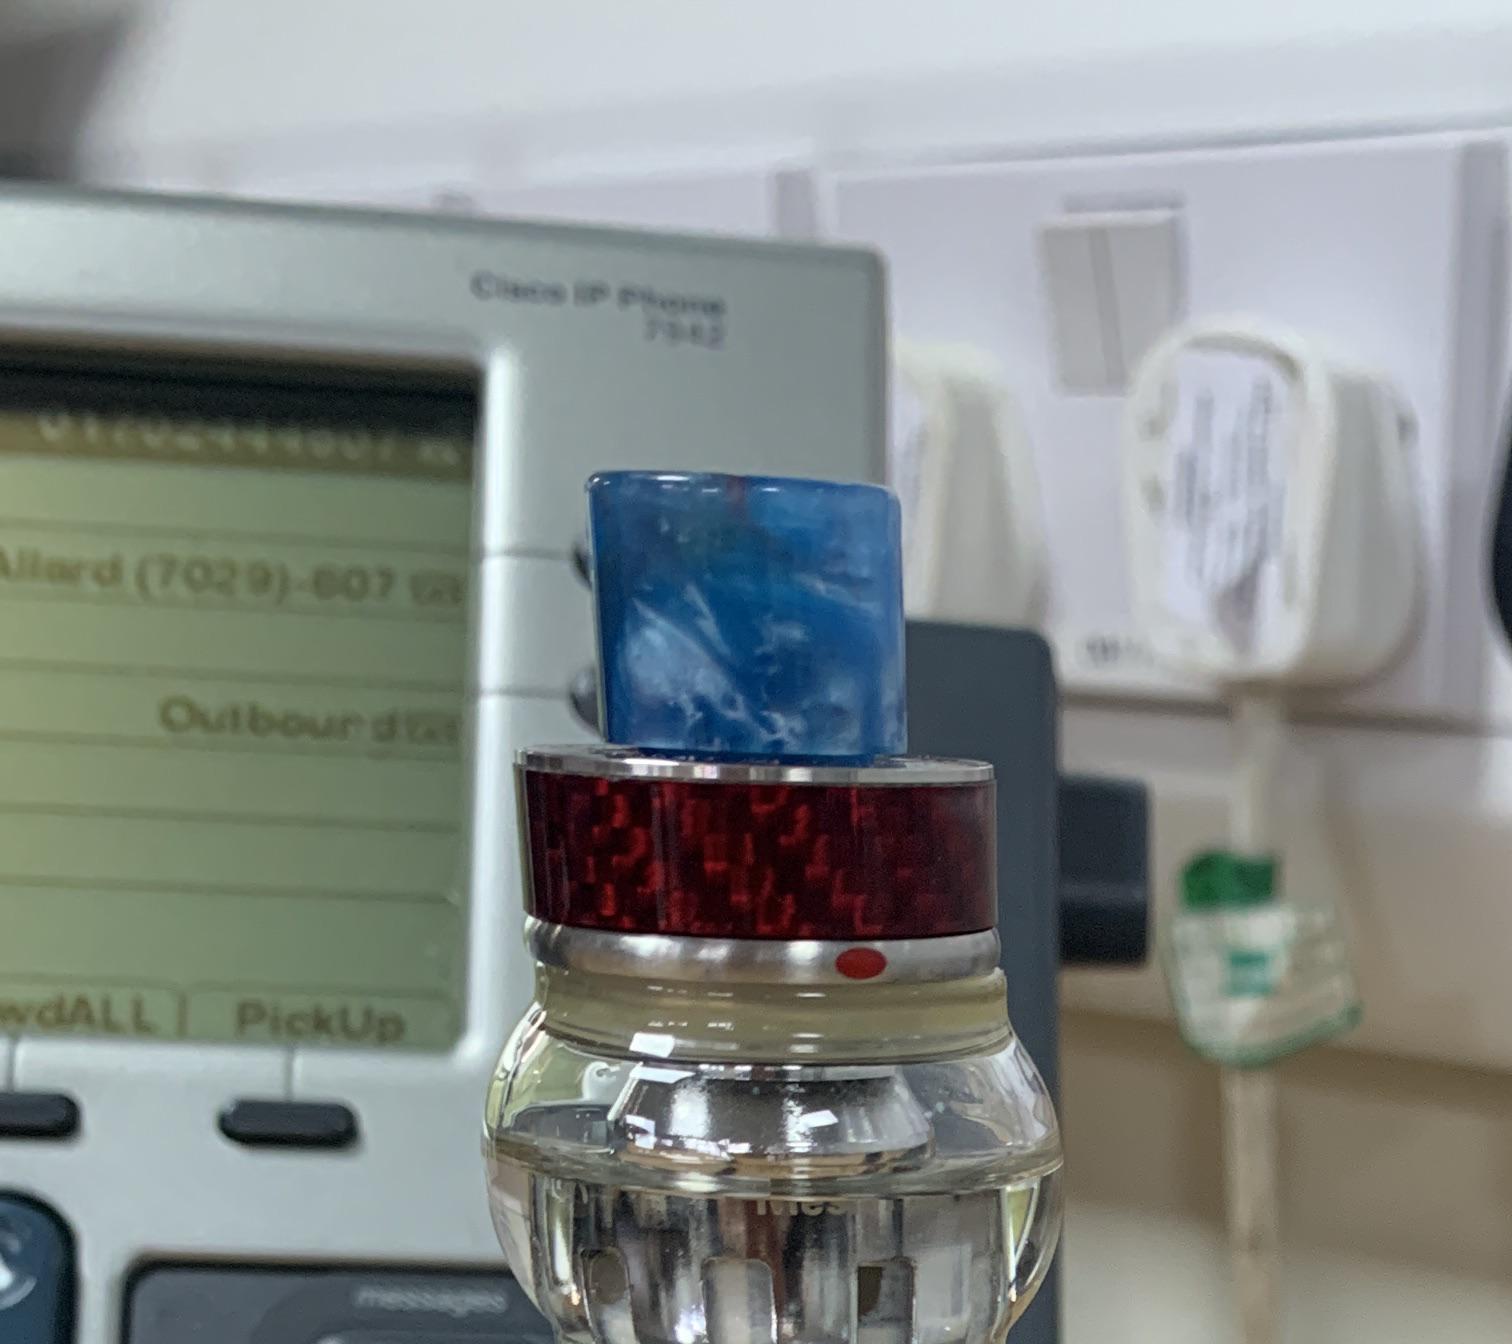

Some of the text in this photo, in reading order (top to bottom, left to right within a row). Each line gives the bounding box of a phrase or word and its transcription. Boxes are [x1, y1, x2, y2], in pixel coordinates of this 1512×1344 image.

[470, 271, 726, 316] Cisco IP Phone
[233, 1000, 406, 1044] PickUp
